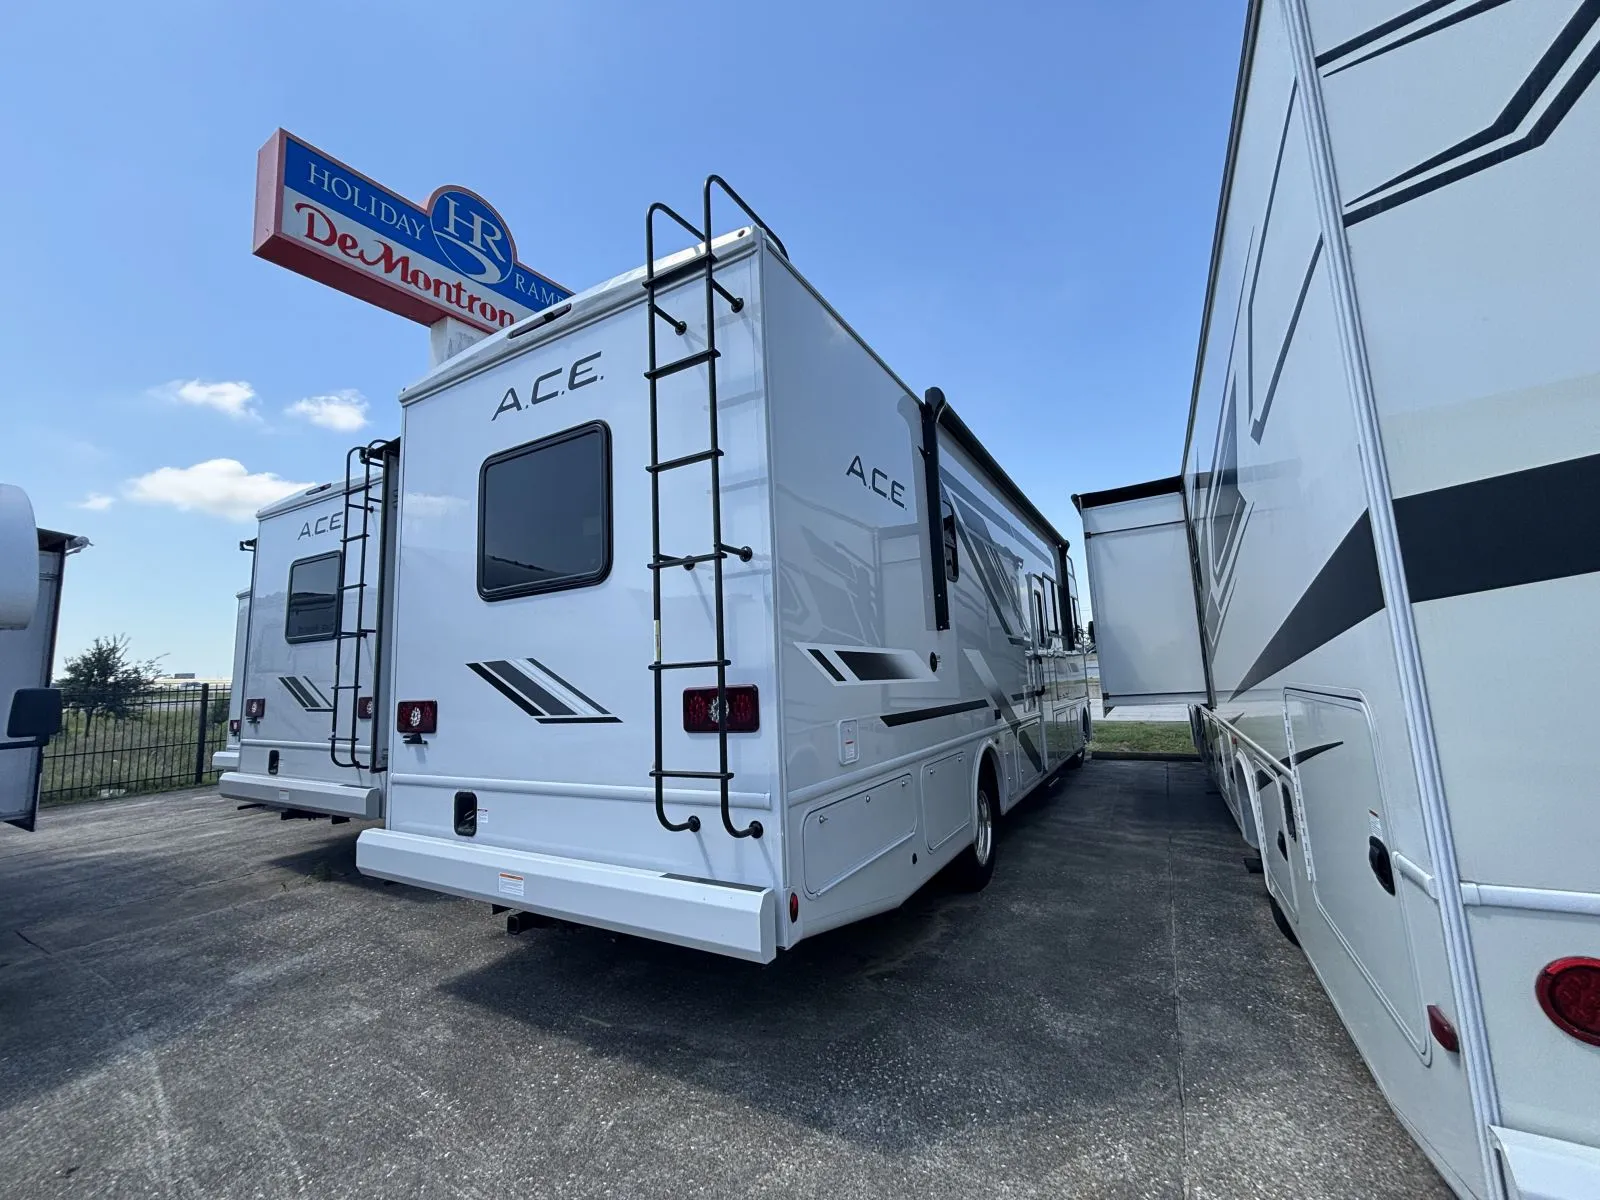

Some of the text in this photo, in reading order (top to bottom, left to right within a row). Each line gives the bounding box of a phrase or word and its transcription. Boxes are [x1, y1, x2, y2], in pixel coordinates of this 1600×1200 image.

[308, 161, 426, 240] HOLIDAY
[491, 350, 604, 421] A.C.E.
[846, 455, 907, 511] A.C.E.
